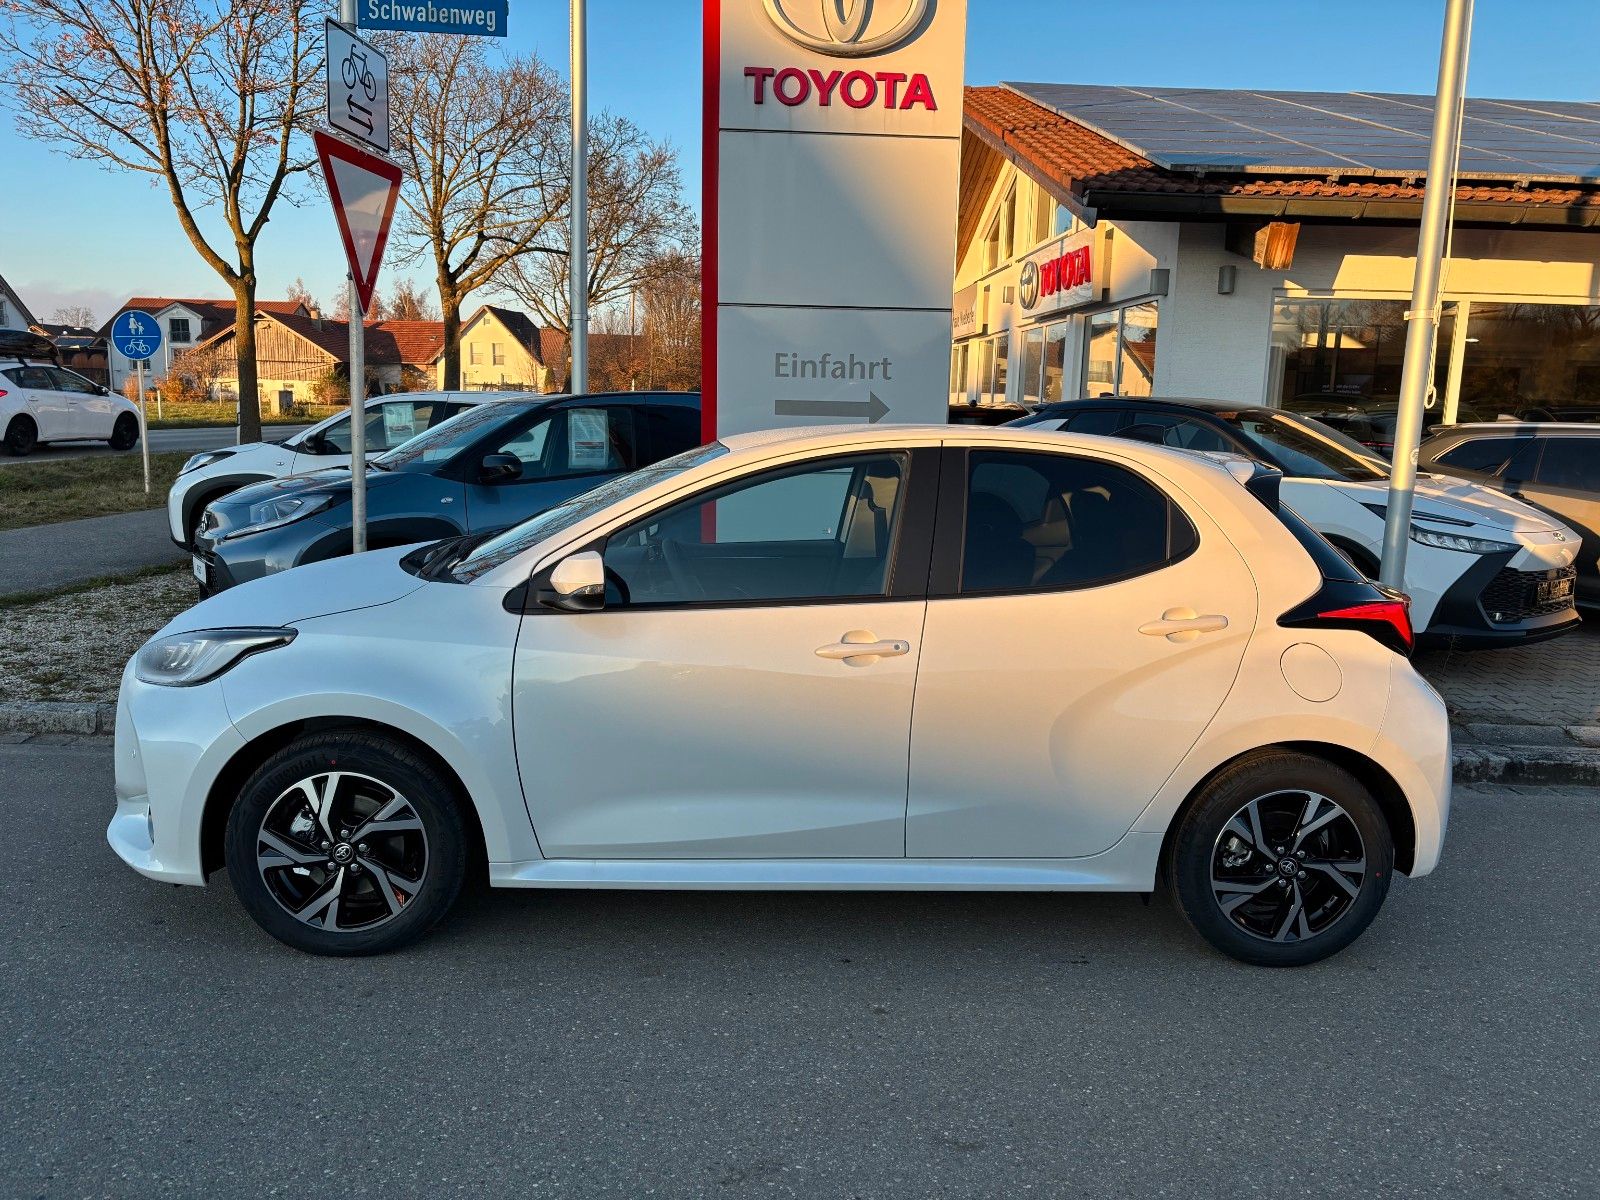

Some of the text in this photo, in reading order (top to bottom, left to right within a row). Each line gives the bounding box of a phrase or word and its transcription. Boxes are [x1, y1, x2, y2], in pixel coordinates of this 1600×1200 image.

[368, 0, 496, 32] Schwabenweg
[744, 67, 938, 110] TOYOTA
[1040, 246, 1091, 297] TOYOTA
[775, 352, 893, 381] Einfahrt
